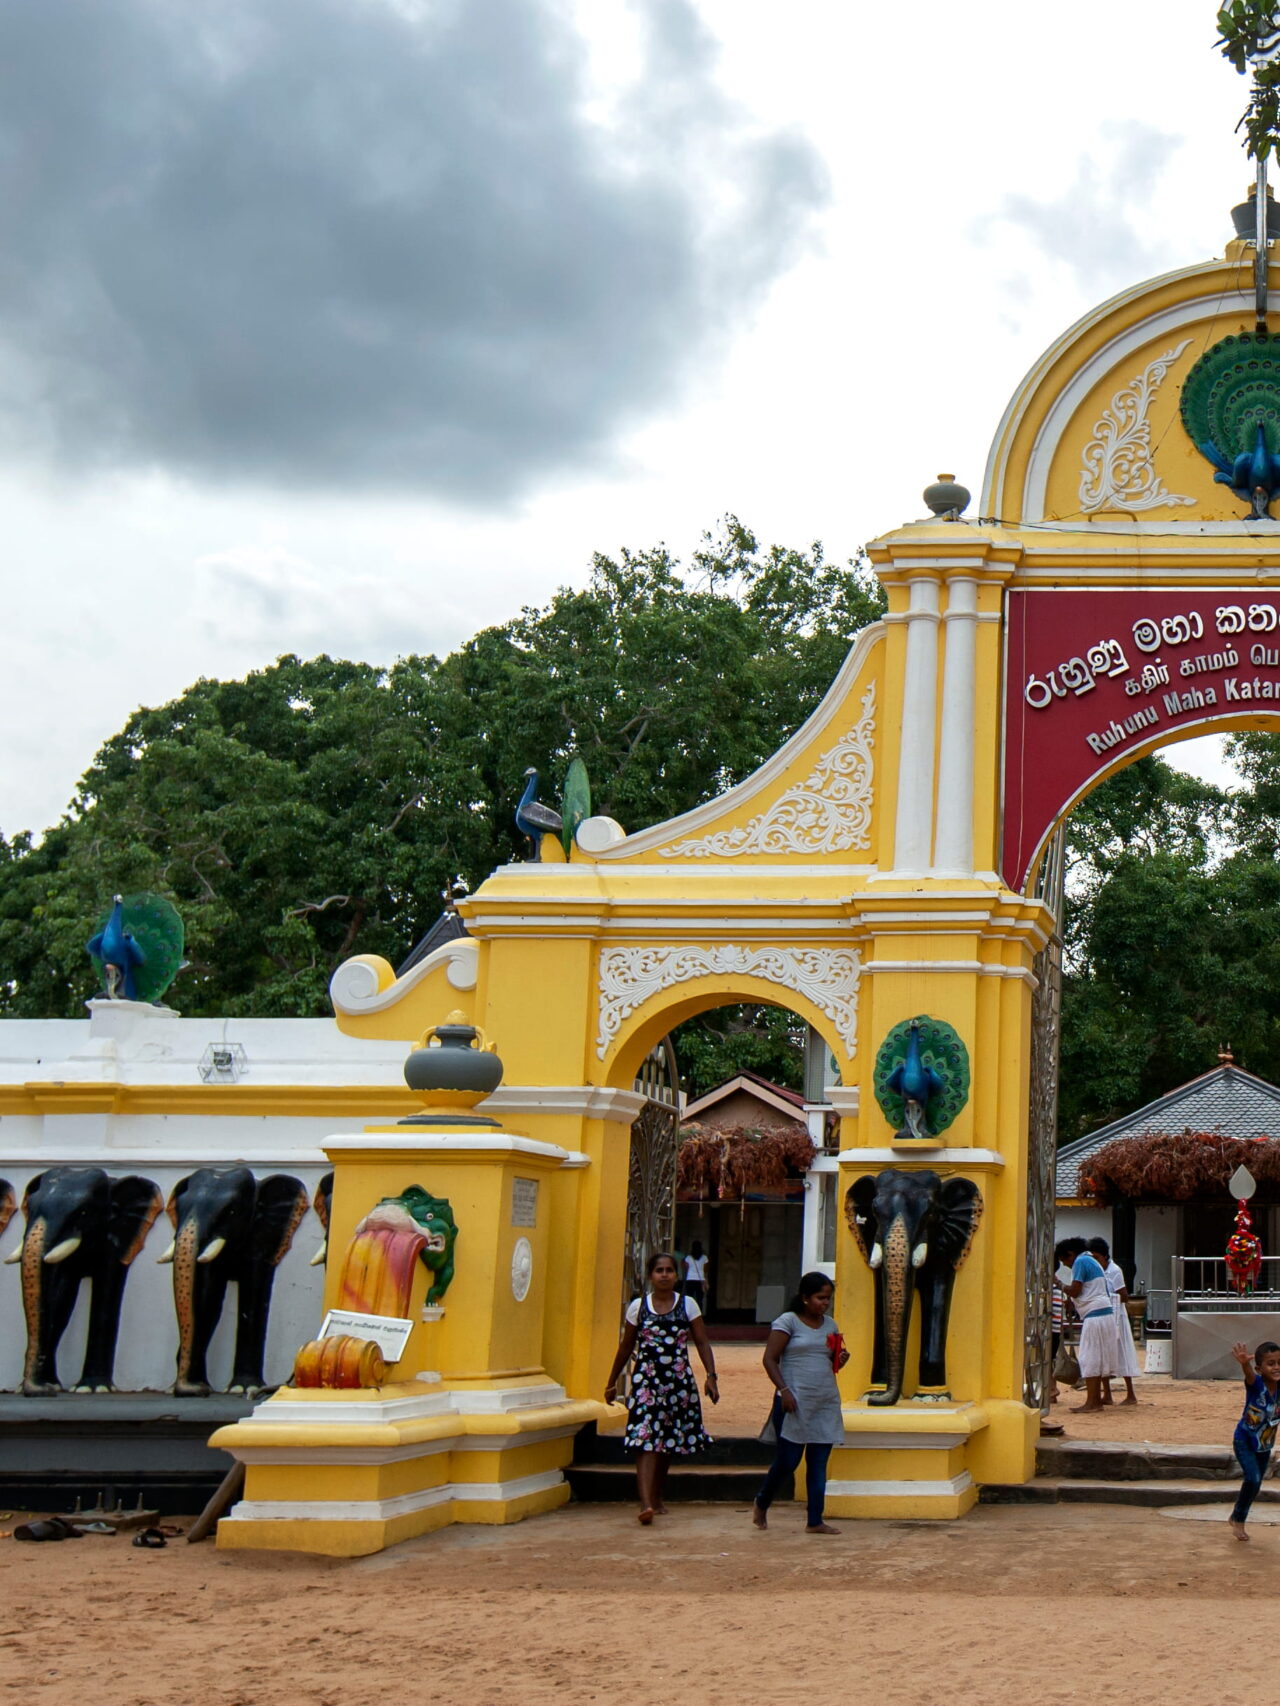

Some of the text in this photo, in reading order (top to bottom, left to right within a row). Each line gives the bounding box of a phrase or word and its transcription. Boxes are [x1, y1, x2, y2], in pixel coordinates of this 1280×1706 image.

[1025, 639, 1129, 708] රුහුණු
[1132, 611, 1203, 653] මහා
[1125, 657, 1169, 696] கதிர்
[1180, 643, 1239, 676] காமம்
[1086, 706, 1159, 756] Ruhunu
[1163, 686, 1217, 716] Maha
